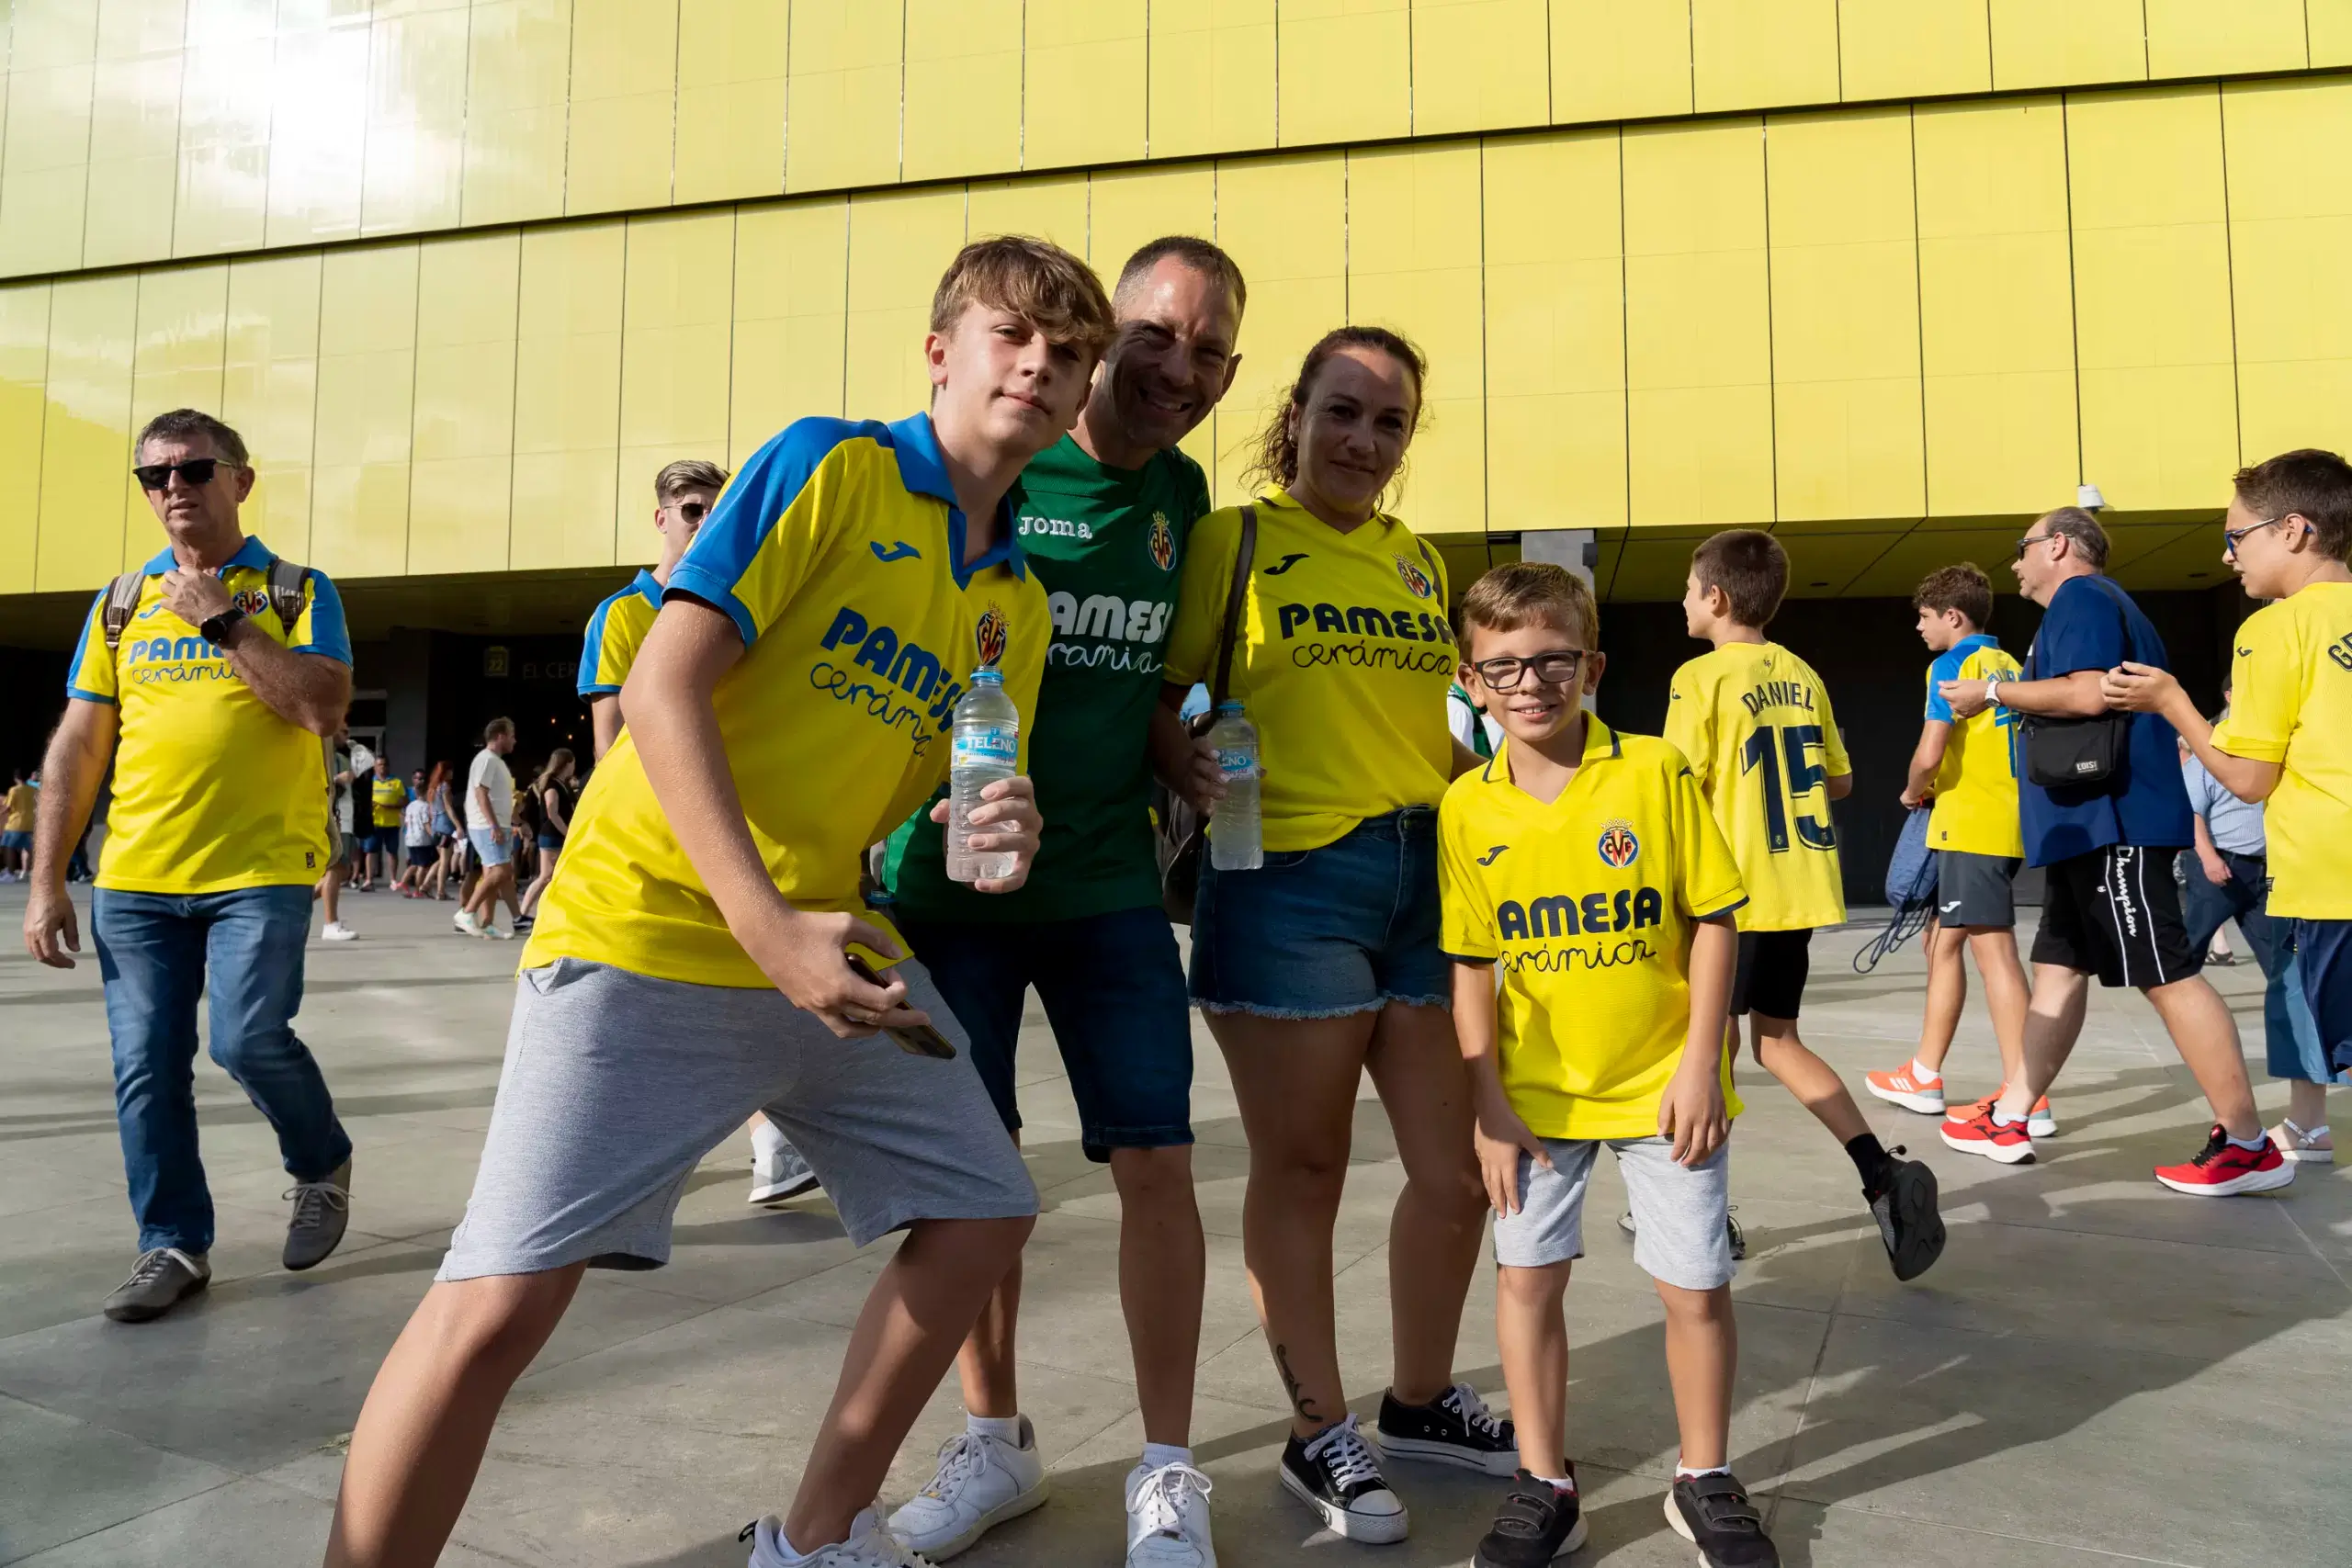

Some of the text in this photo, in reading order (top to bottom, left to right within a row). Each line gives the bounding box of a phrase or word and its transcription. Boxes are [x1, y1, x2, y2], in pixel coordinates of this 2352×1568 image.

[1047, 591, 1174, 643] AMES
[1278, 603, 1459, 649] PAMESA
[1293, 639, 1453, 676] cerámica
[1741, 681, 1815, 718] DANIEL
[967, 736, 1016, 753] TELENO
[1740, 725, 1838, 853] 15
